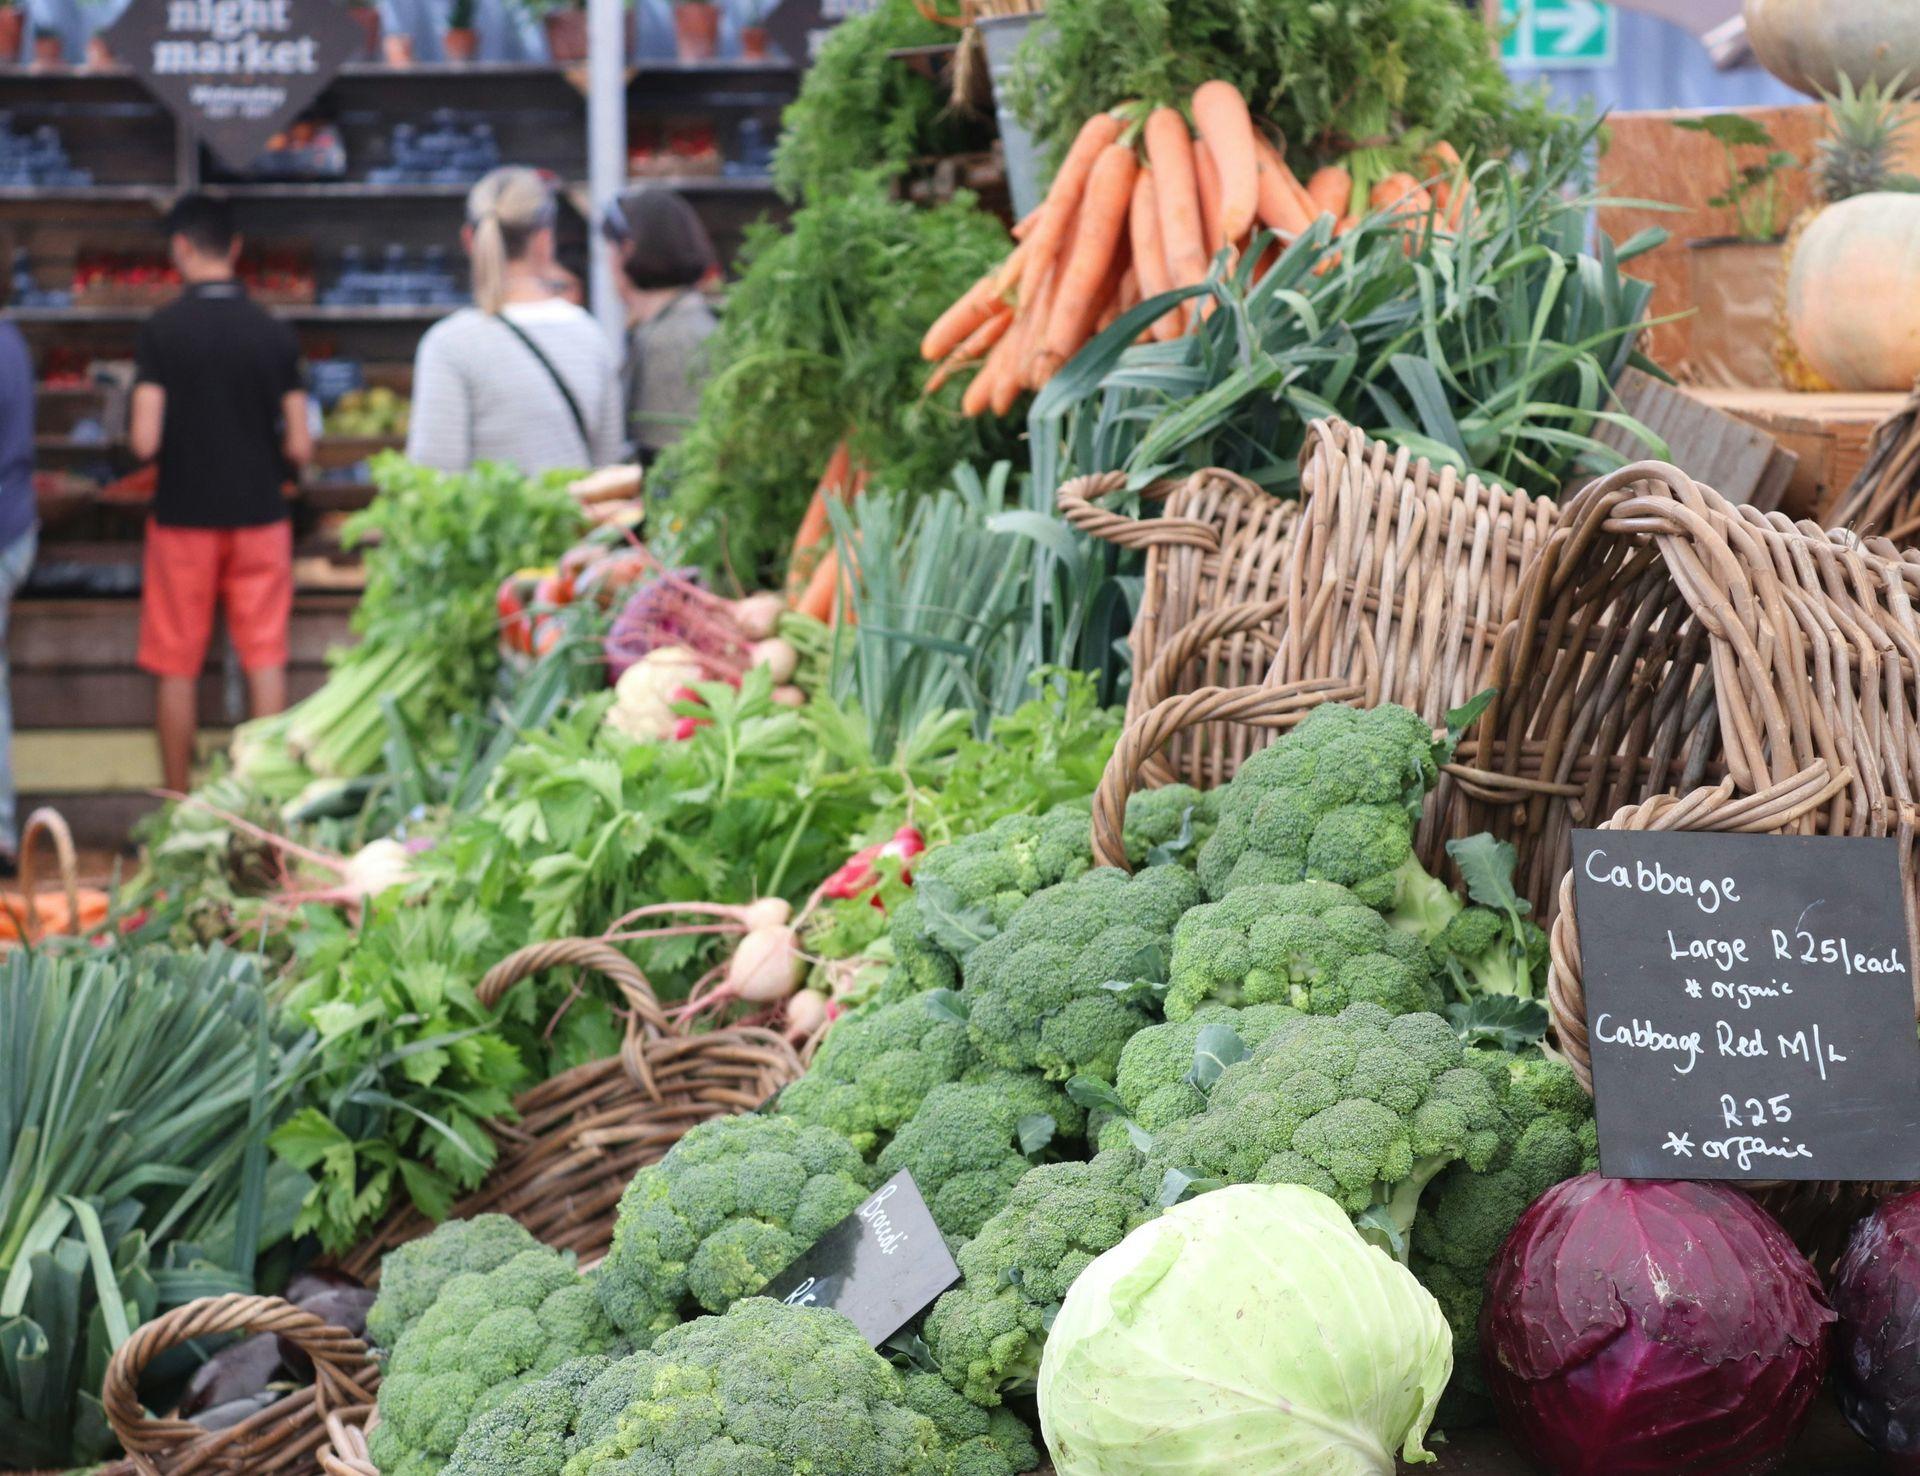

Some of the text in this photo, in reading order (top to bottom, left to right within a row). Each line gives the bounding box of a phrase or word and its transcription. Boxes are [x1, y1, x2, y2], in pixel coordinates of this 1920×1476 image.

[152, 32, 318, 75] market
[1586, 850, 1740, 913] Cabbage
[1668, 930, 1749, 971] Large
[1596, 1014, 1704, 1073] Cabbage
[1716, 1021, 1768, 1057] Red
[1720, 1094, 1791, 1128] R25
